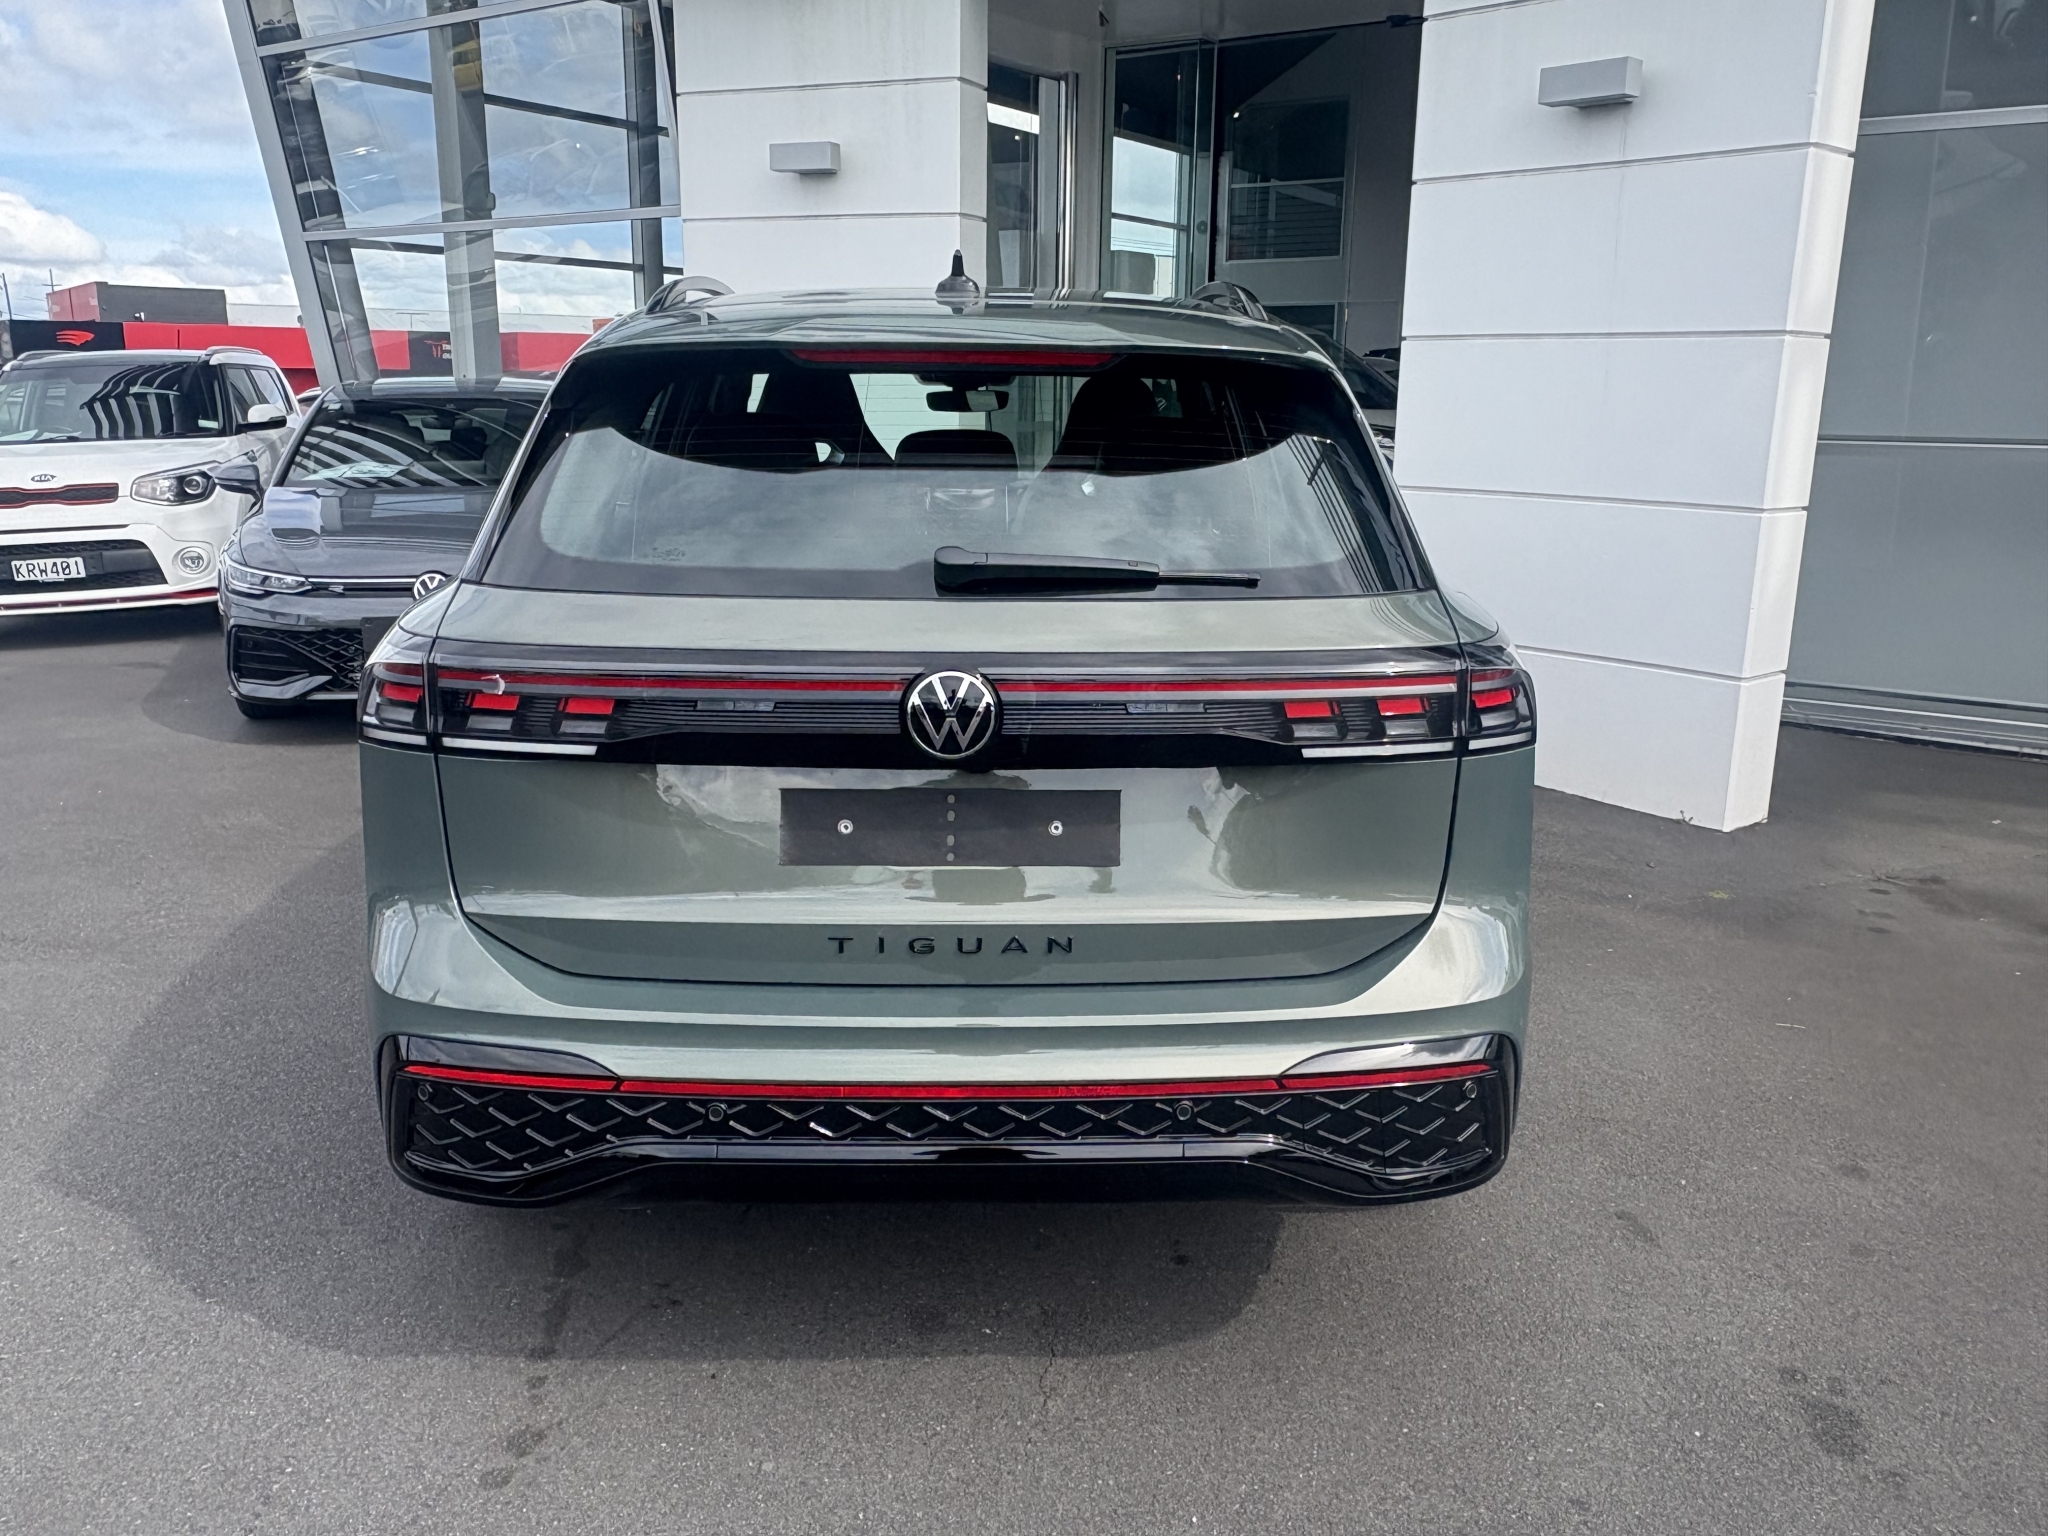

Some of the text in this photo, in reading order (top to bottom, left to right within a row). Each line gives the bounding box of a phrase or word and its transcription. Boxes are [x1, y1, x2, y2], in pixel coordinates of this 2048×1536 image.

[33, 474, 54, 482] KIA
[14, 560, 81, 578] KRW401
[909, 673, 993, 755] VW
[827, 935, 1074, 955] TIGUAN
